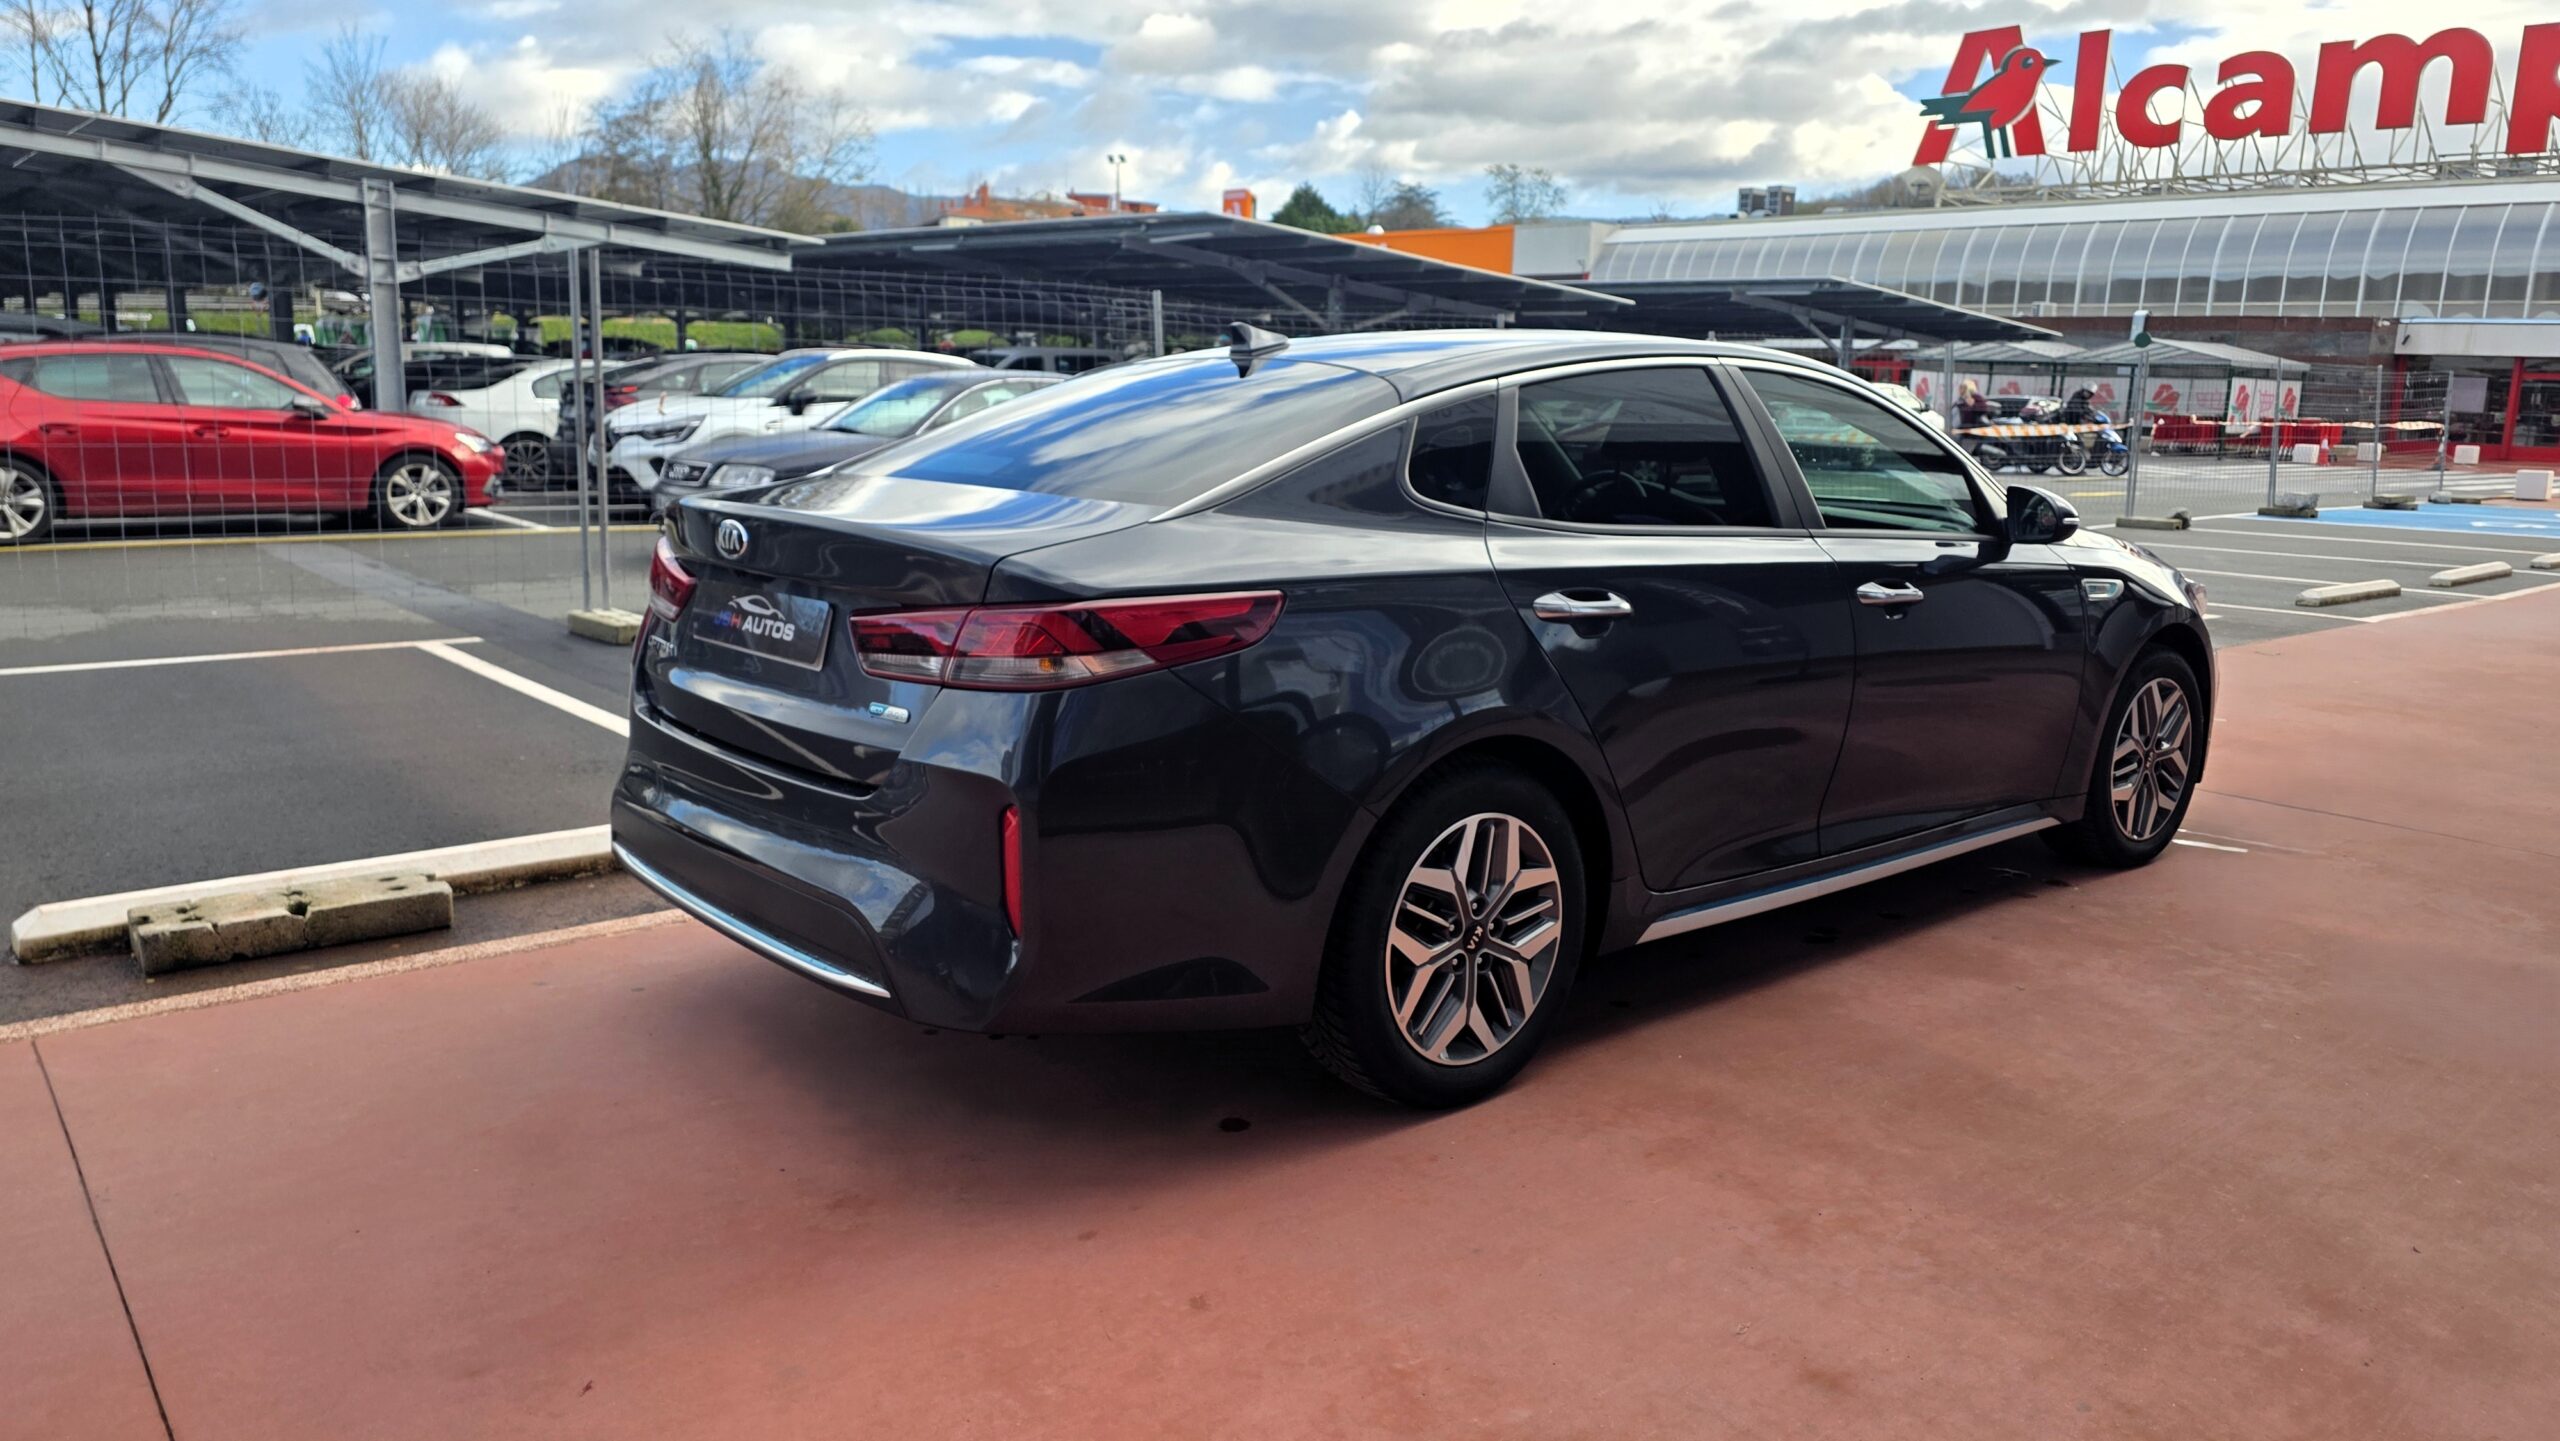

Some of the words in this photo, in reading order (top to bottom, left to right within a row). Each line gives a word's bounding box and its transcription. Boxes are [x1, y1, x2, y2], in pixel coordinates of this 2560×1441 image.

[719, 527, 740, 551] KIA
[741, 615, 796, 642] AUTOS
[1466, 925, 1484, 949] KIA
